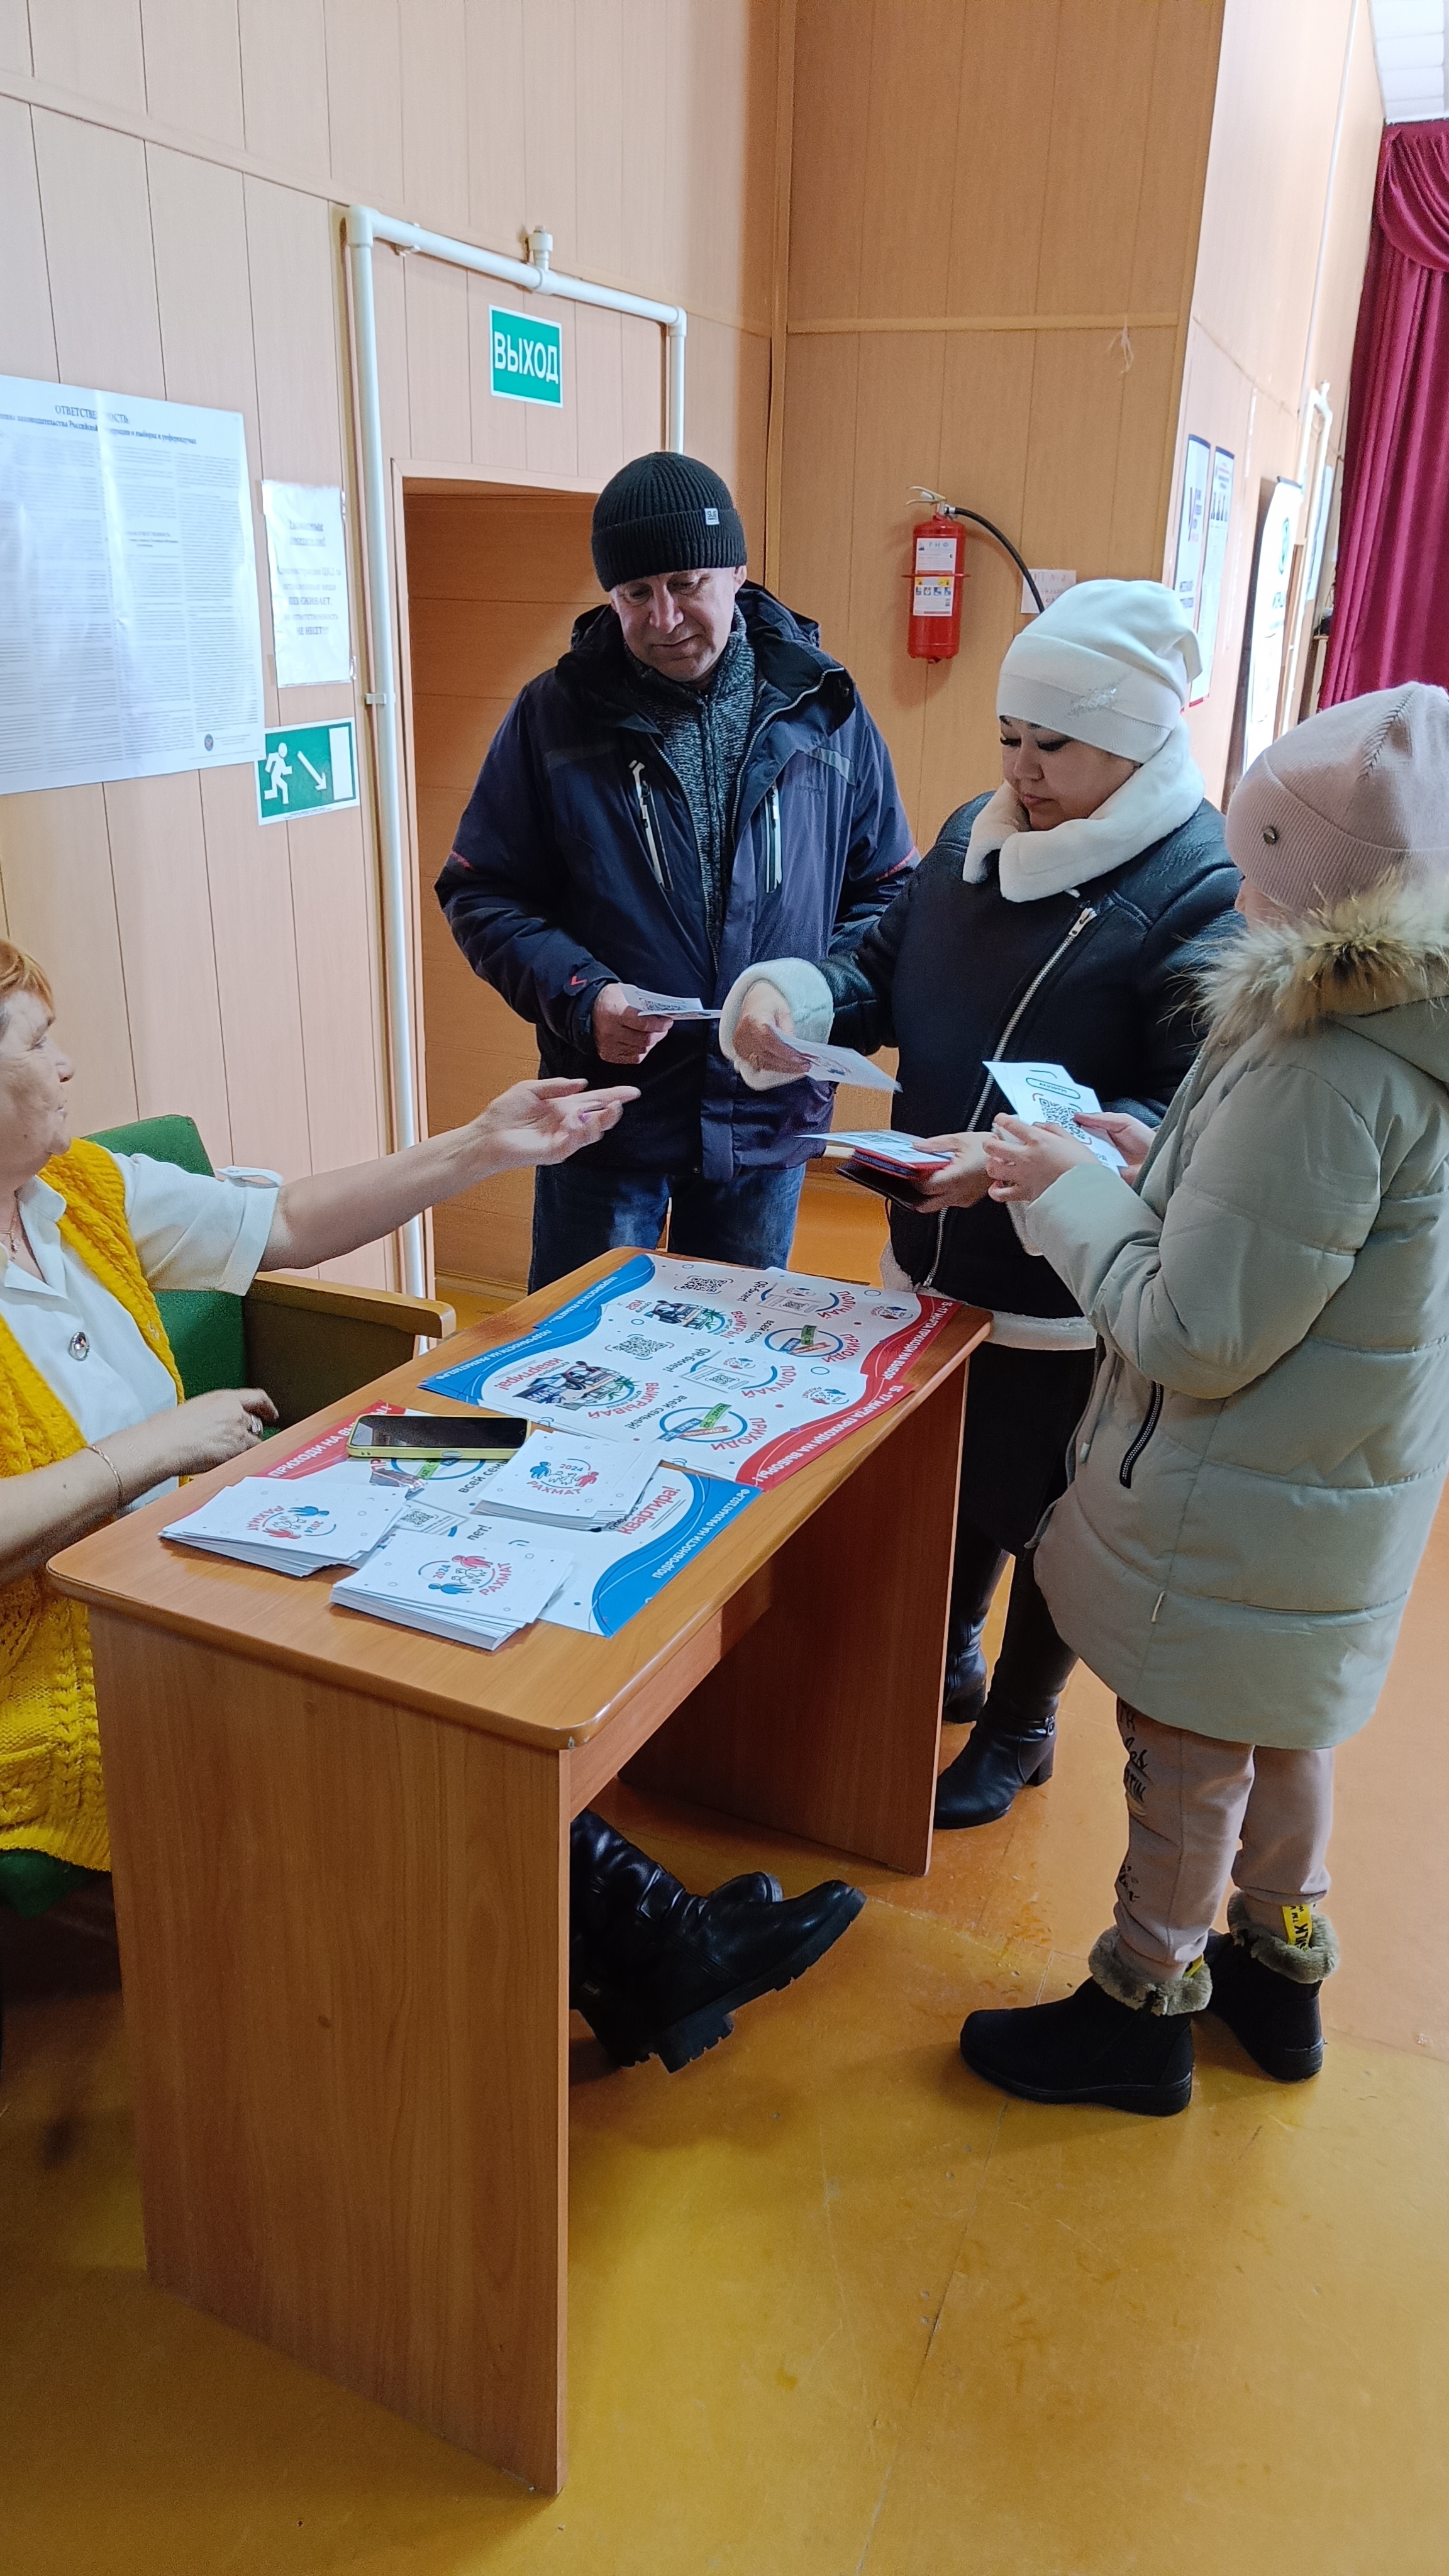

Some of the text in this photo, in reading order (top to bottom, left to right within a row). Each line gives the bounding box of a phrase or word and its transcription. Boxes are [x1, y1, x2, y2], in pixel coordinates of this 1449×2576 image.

[494, 331, 558, 384] ВЫХОД
[55, 404, 129, 424] ОТВЕТСТВЕОСТЬ
[817, 1291, 856, 1319] ПОЛУЧАЙ
[662, 1348, 711, 1373] QR-билет!
[821, 1333, 862, 1363] ПРИХОДИ
[741, 1365, 797, 1399] ПОЛУЧАЙ
[588, 1382, 660, 1419] ВЫИГРЫВАЙ
[662, 1395, 687, 1409] всей
[624, 1408, 665, 1430] семьей!
[711, 1417, 767, 1450] ПРИХОДИ
[752, 1385, 904, 1482] 15-17 МАРТА ПРИХОДИ НА ВЫБОРЫ!
[268, 1445, 326, 1478] ПРИХОДИ
[321, 1435, 340, 1446] НА
[558, 1463, 584, 1472] 2024
[458, 1475, 486, 1493] всей
[526, 1480, 583, 1496] РАХМАТ
[245, 1505, 284, 1531] РАХМАТ
[618, 1485, 682, 1536] квартира!
[304, 1520, 325, 1533] 2024
[652, 1533, 704, 1579] ПОДРОБНОСТИ
[697, 1523, 714, 1537] НА
[706, 1489, 751, 1529] РАХМАТ102.РФ
[433, 1563, 452, 1579] 2024
[479, 1562, 513, 1596] РАХМАТ
